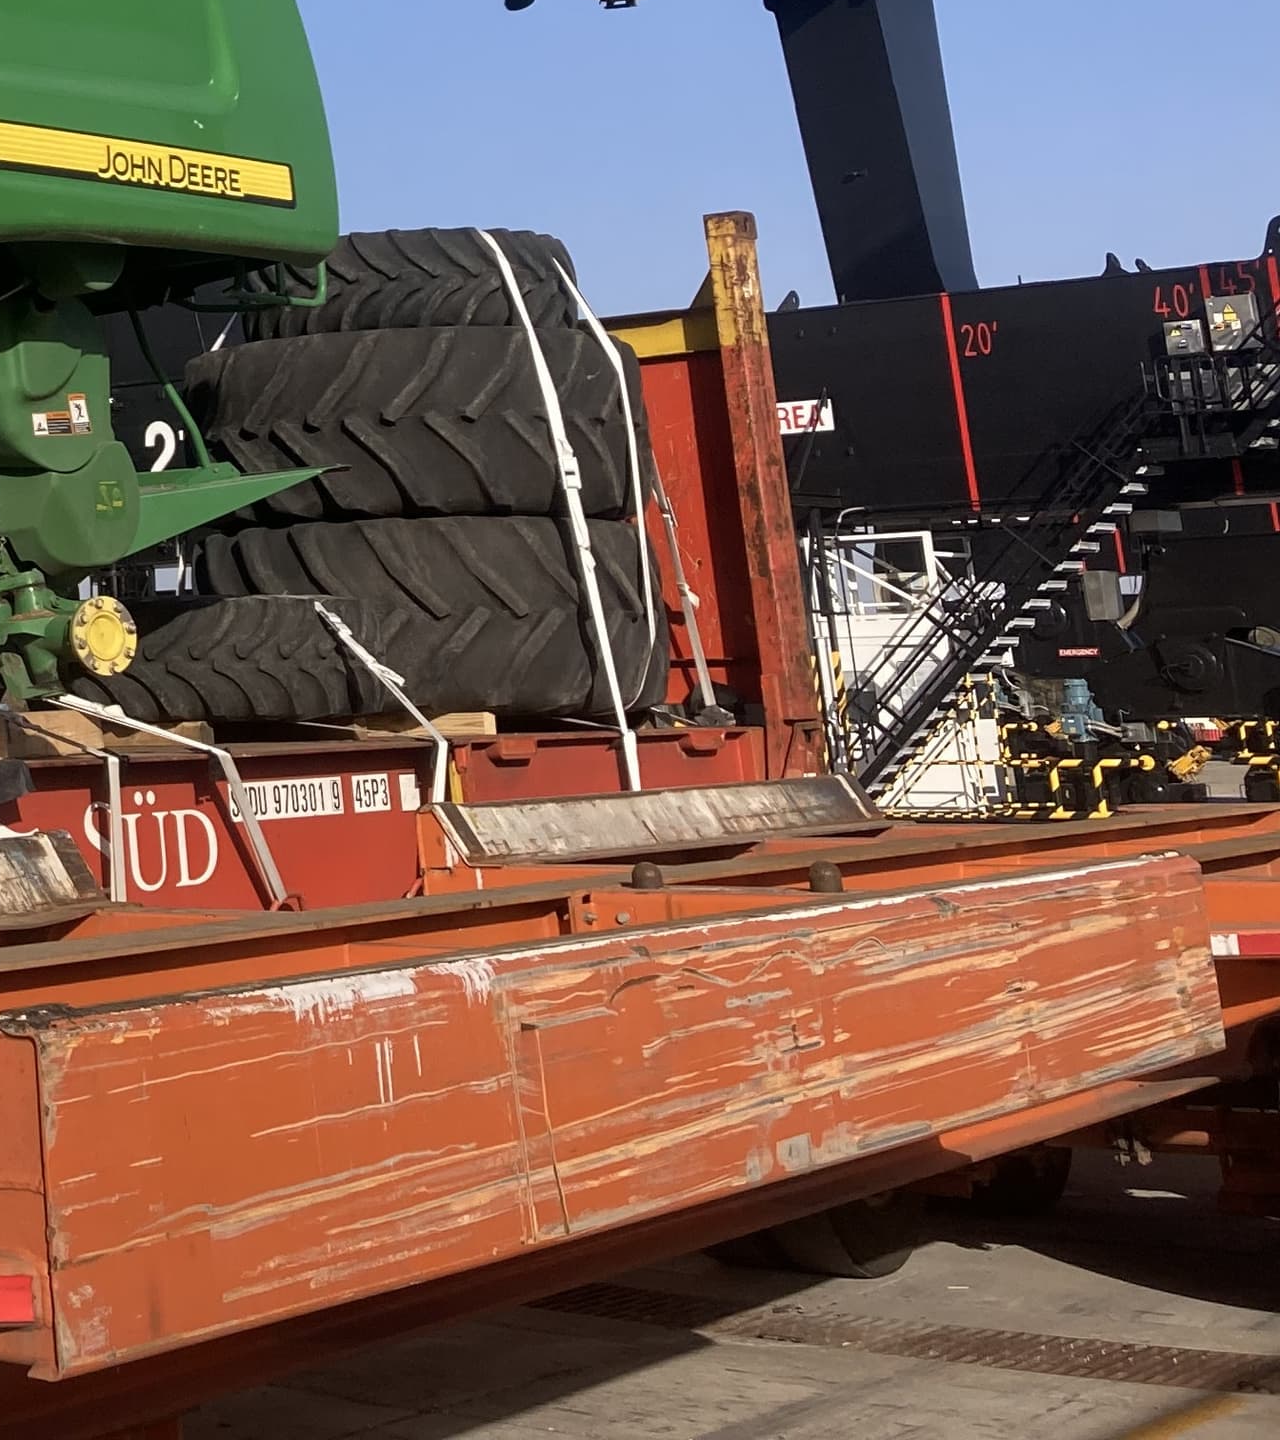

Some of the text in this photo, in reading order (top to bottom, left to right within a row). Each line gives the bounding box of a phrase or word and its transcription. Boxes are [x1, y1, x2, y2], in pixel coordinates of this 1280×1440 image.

[97, 144, 243, 193] JOHN DEERE
[1153, 282, 1195, 319] 40'
[960, 321, 998, 358] 20'
[230, 776, 389, 818] SDU 970301 9 45P3
